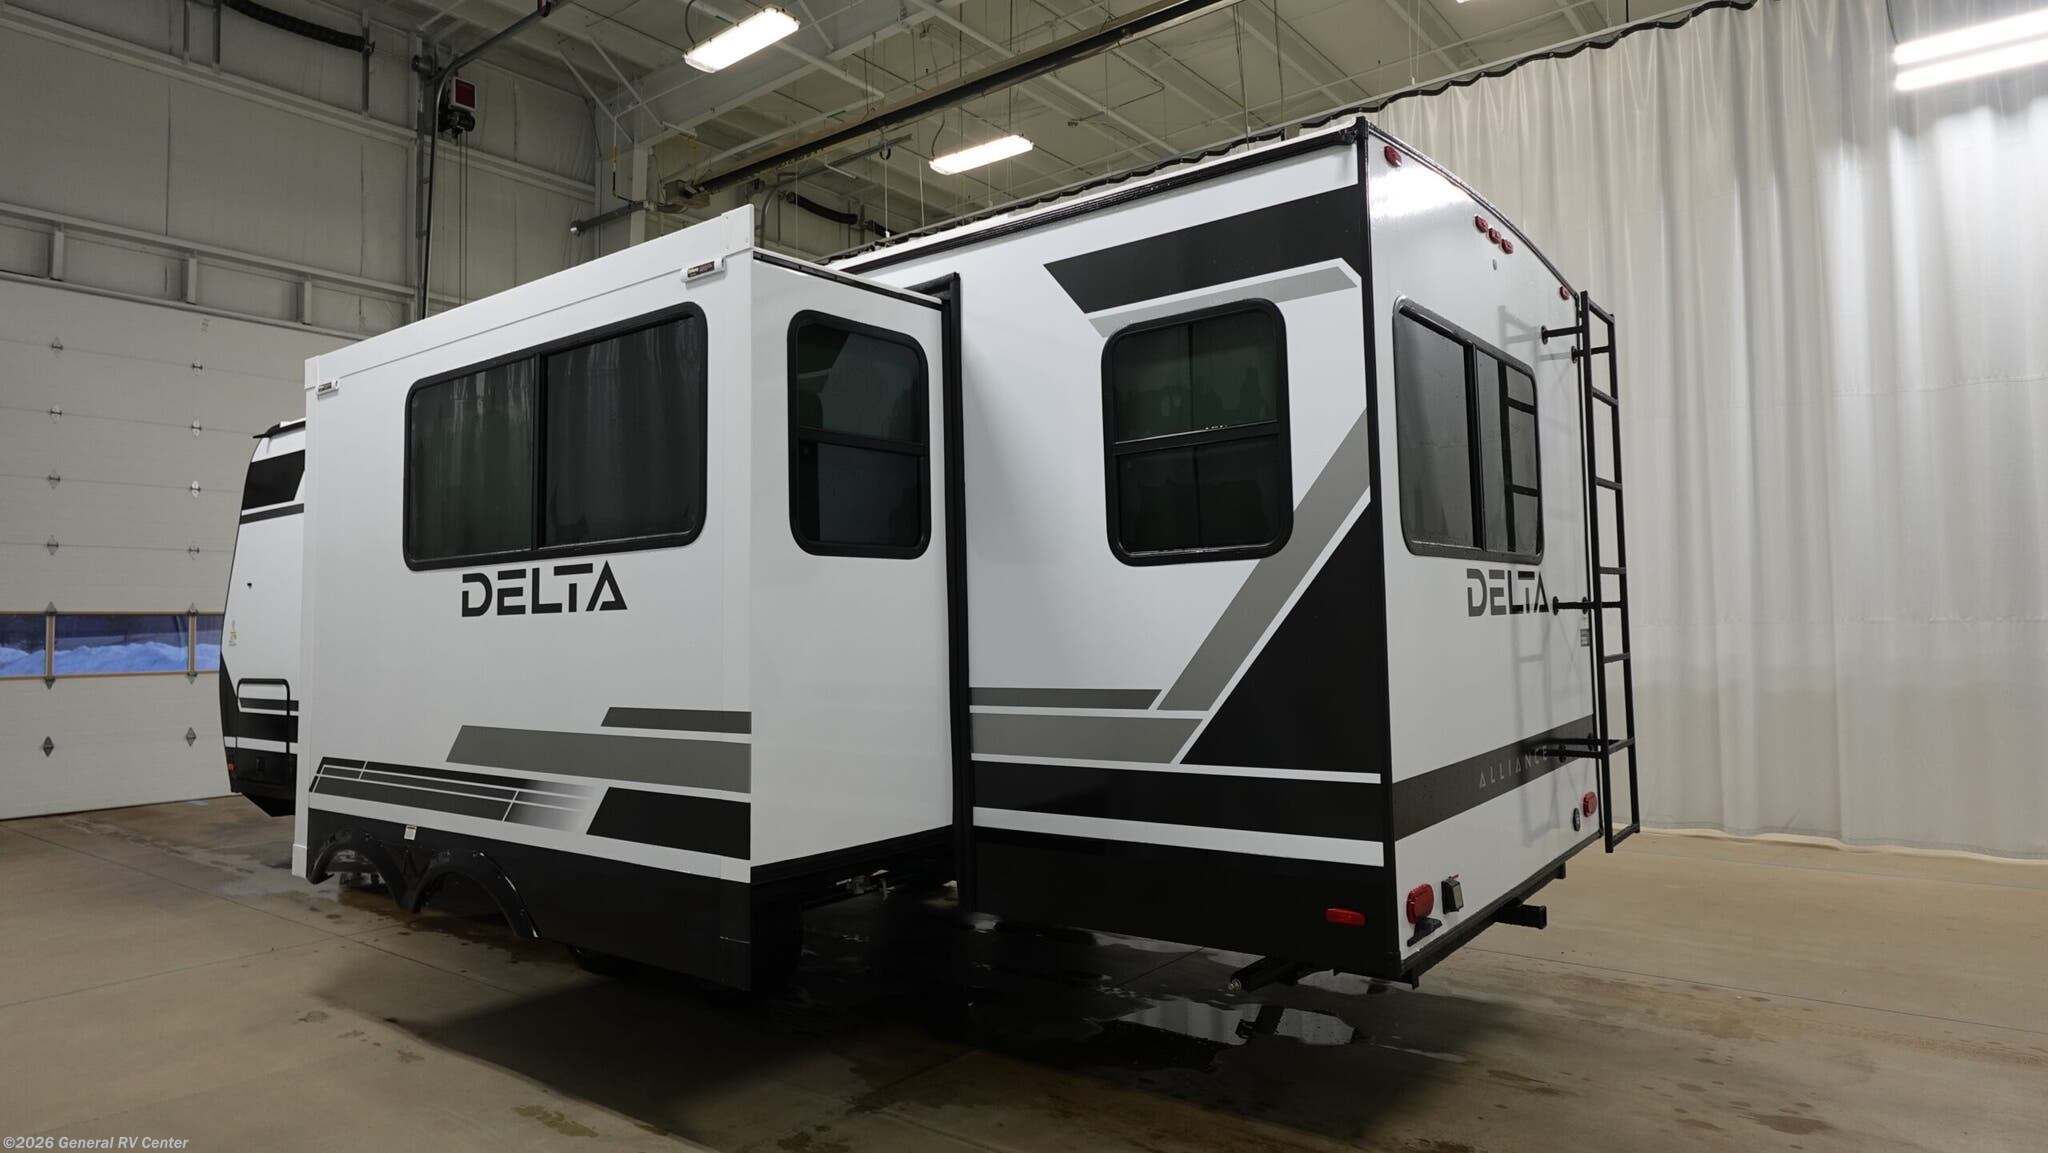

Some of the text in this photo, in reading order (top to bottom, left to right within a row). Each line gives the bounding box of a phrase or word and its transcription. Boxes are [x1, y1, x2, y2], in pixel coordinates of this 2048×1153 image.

[461, 560, 628, 618] DELTA
[1466, 568, 1550, 617] DELTA
[1479, 745, 1548, 789] ALLIANCE
